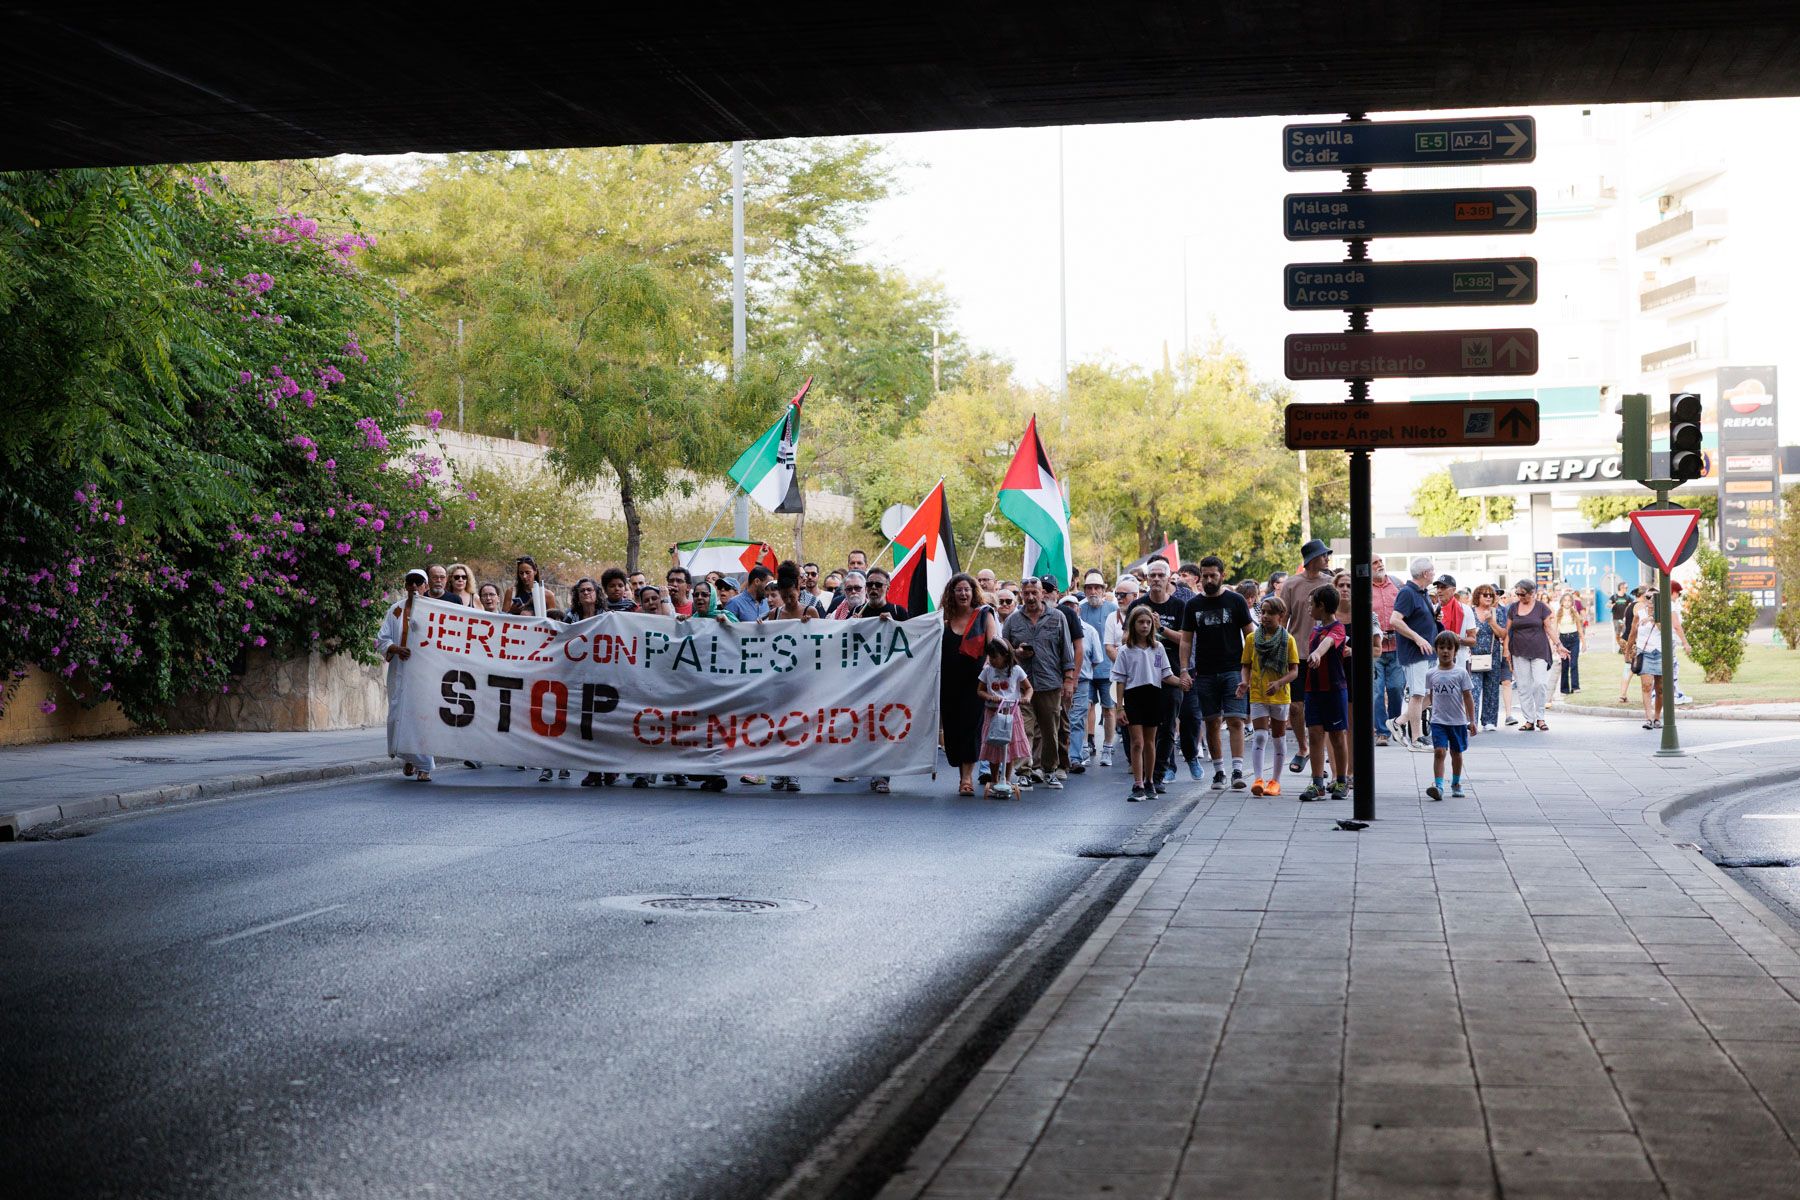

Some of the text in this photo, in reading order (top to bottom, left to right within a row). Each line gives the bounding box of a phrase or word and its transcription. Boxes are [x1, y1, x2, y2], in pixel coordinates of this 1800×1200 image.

[1291, 131, 1489, 148] Sevilla E-5 AP-4
[1291, 148, 1339, 163] Cádiz
[1292, 201, 1349, 216] Málaga
[1293, 218, 1366, 234] Algeciras
[1294, 270, 1492, 288] Granada A-382
[1296, 287, 1349, 302] Arcos
[1293, 341, 1347, 354] Campus
[1293, 354, 1426, 374] Universitario
[1295, 408, 1370, 422] Circuito de
[1723, 416, 1774, 428] REPSOL
[1401, 425, 1448, 440] Nieto
[1516, 456, 1623, 481] REPSO
[420, 612, 913, 674] JEREZ CON PALESTINA
[439, 669, 912, 749] STOP GENOCIDIO
